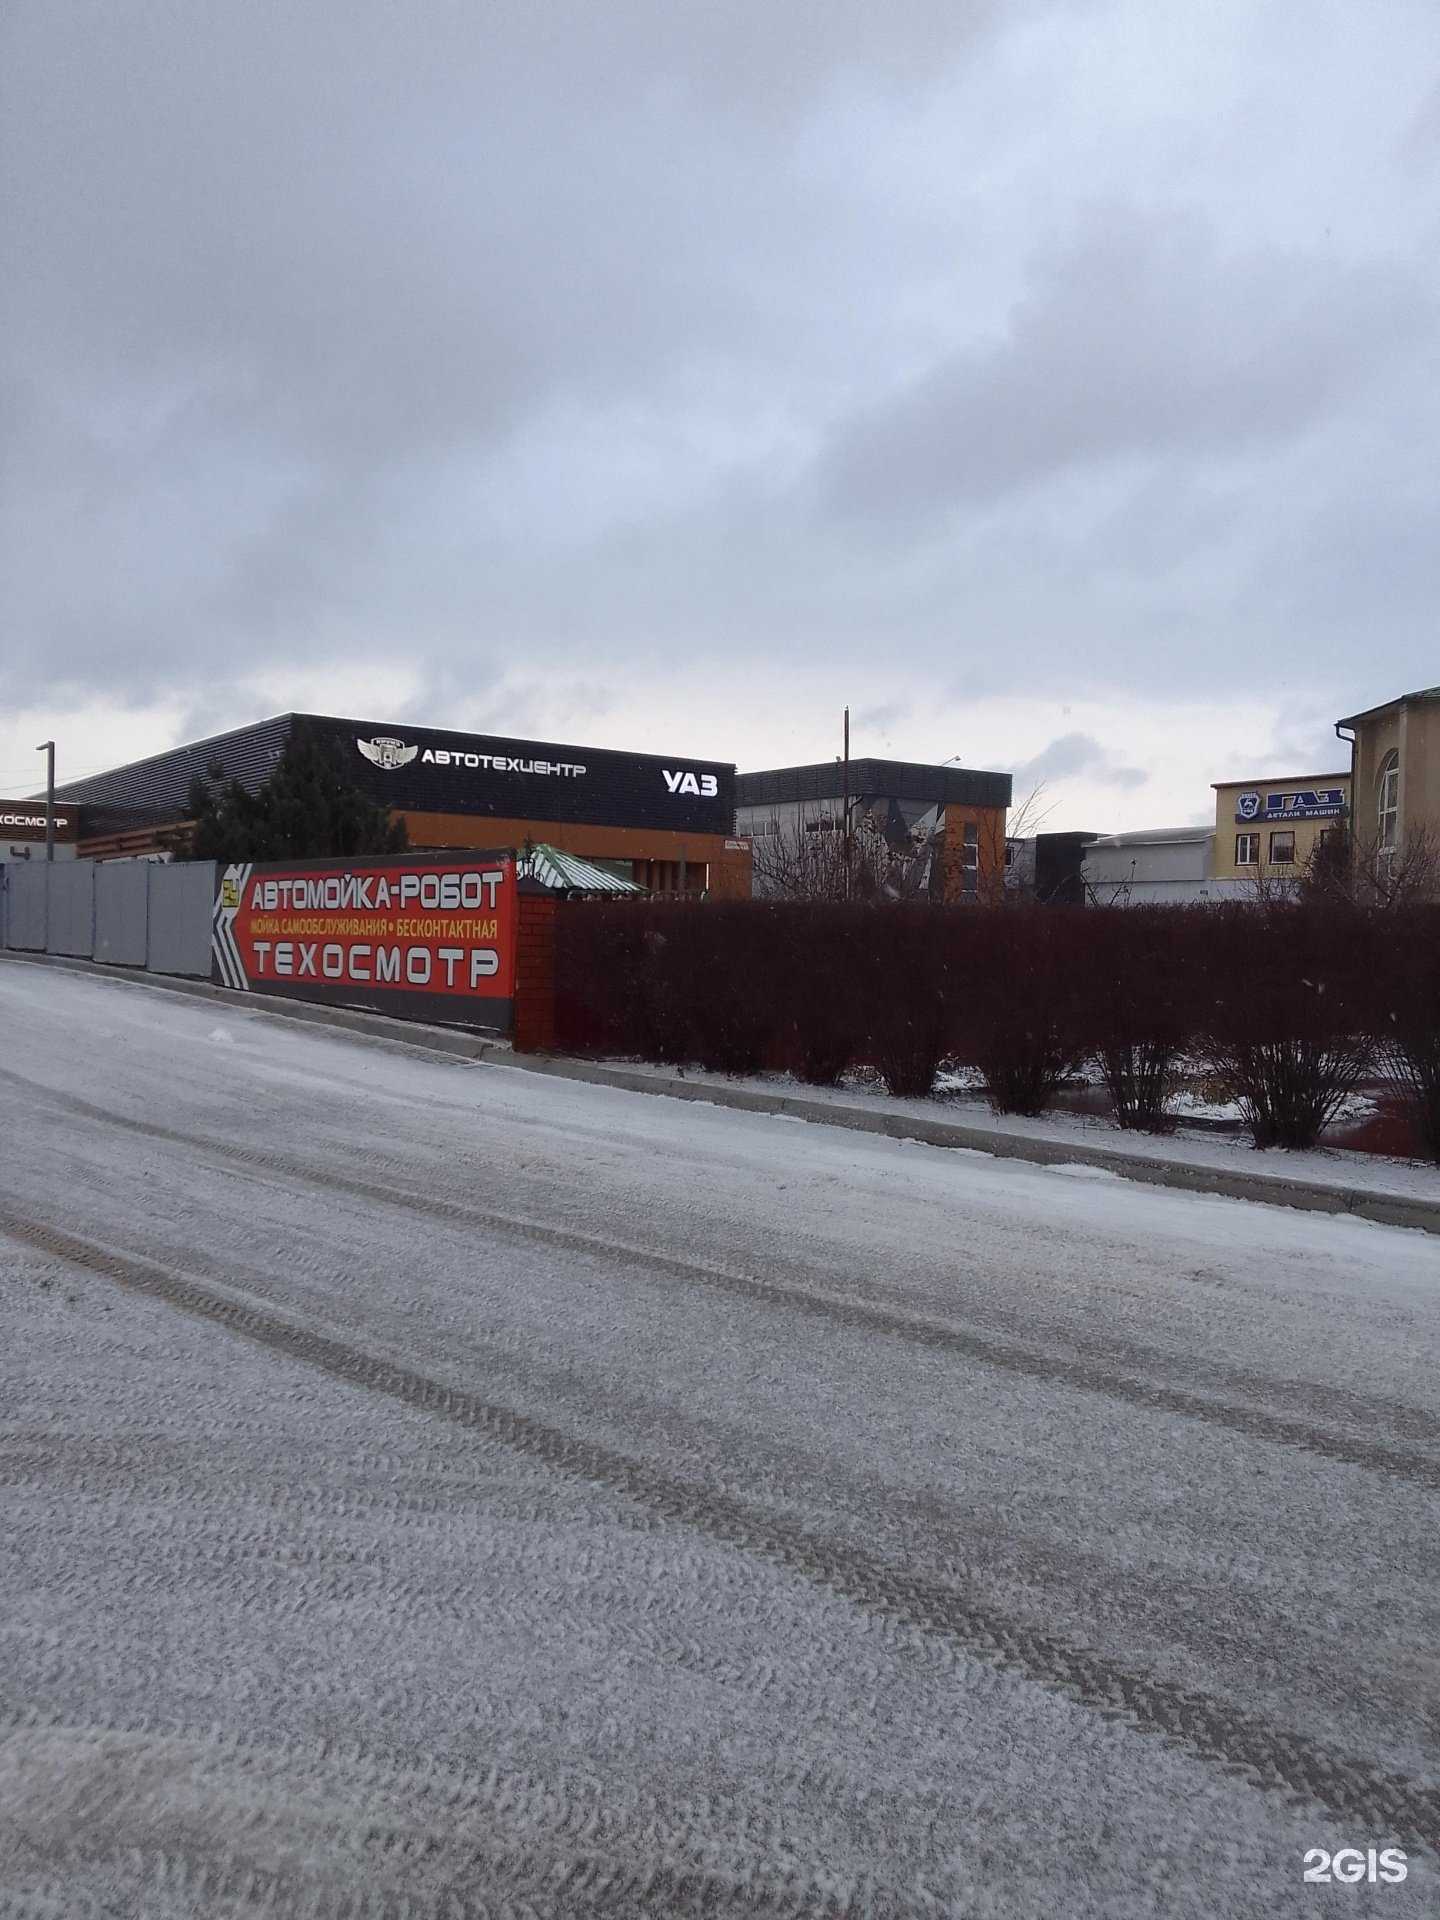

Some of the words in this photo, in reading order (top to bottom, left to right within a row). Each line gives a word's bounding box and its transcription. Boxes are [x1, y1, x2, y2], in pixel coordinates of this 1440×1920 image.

[421, 749, 587, 778] АВТОТЕХЦЕНТР
[662, 770, 718, 797] УАЗ
[1266, 788, 1345, 810] ГАЗ
[1266, 811, 1301, 819] ДЕТАЛИ
[1305, 808, 1340, 817] МАШИН
[251, 872, 503, 910] АВТОМОЙКА-РОБОТ
[250, 915, 280, 934] МОЙКА
[281, 917, 387, 937] САМООБСЛУЖИВАНИЯ
[396, 919, 497, 939] БЕСКОНТАКТНАЯ
[253, 941, 499, 988] ТЕХОСМОТР
